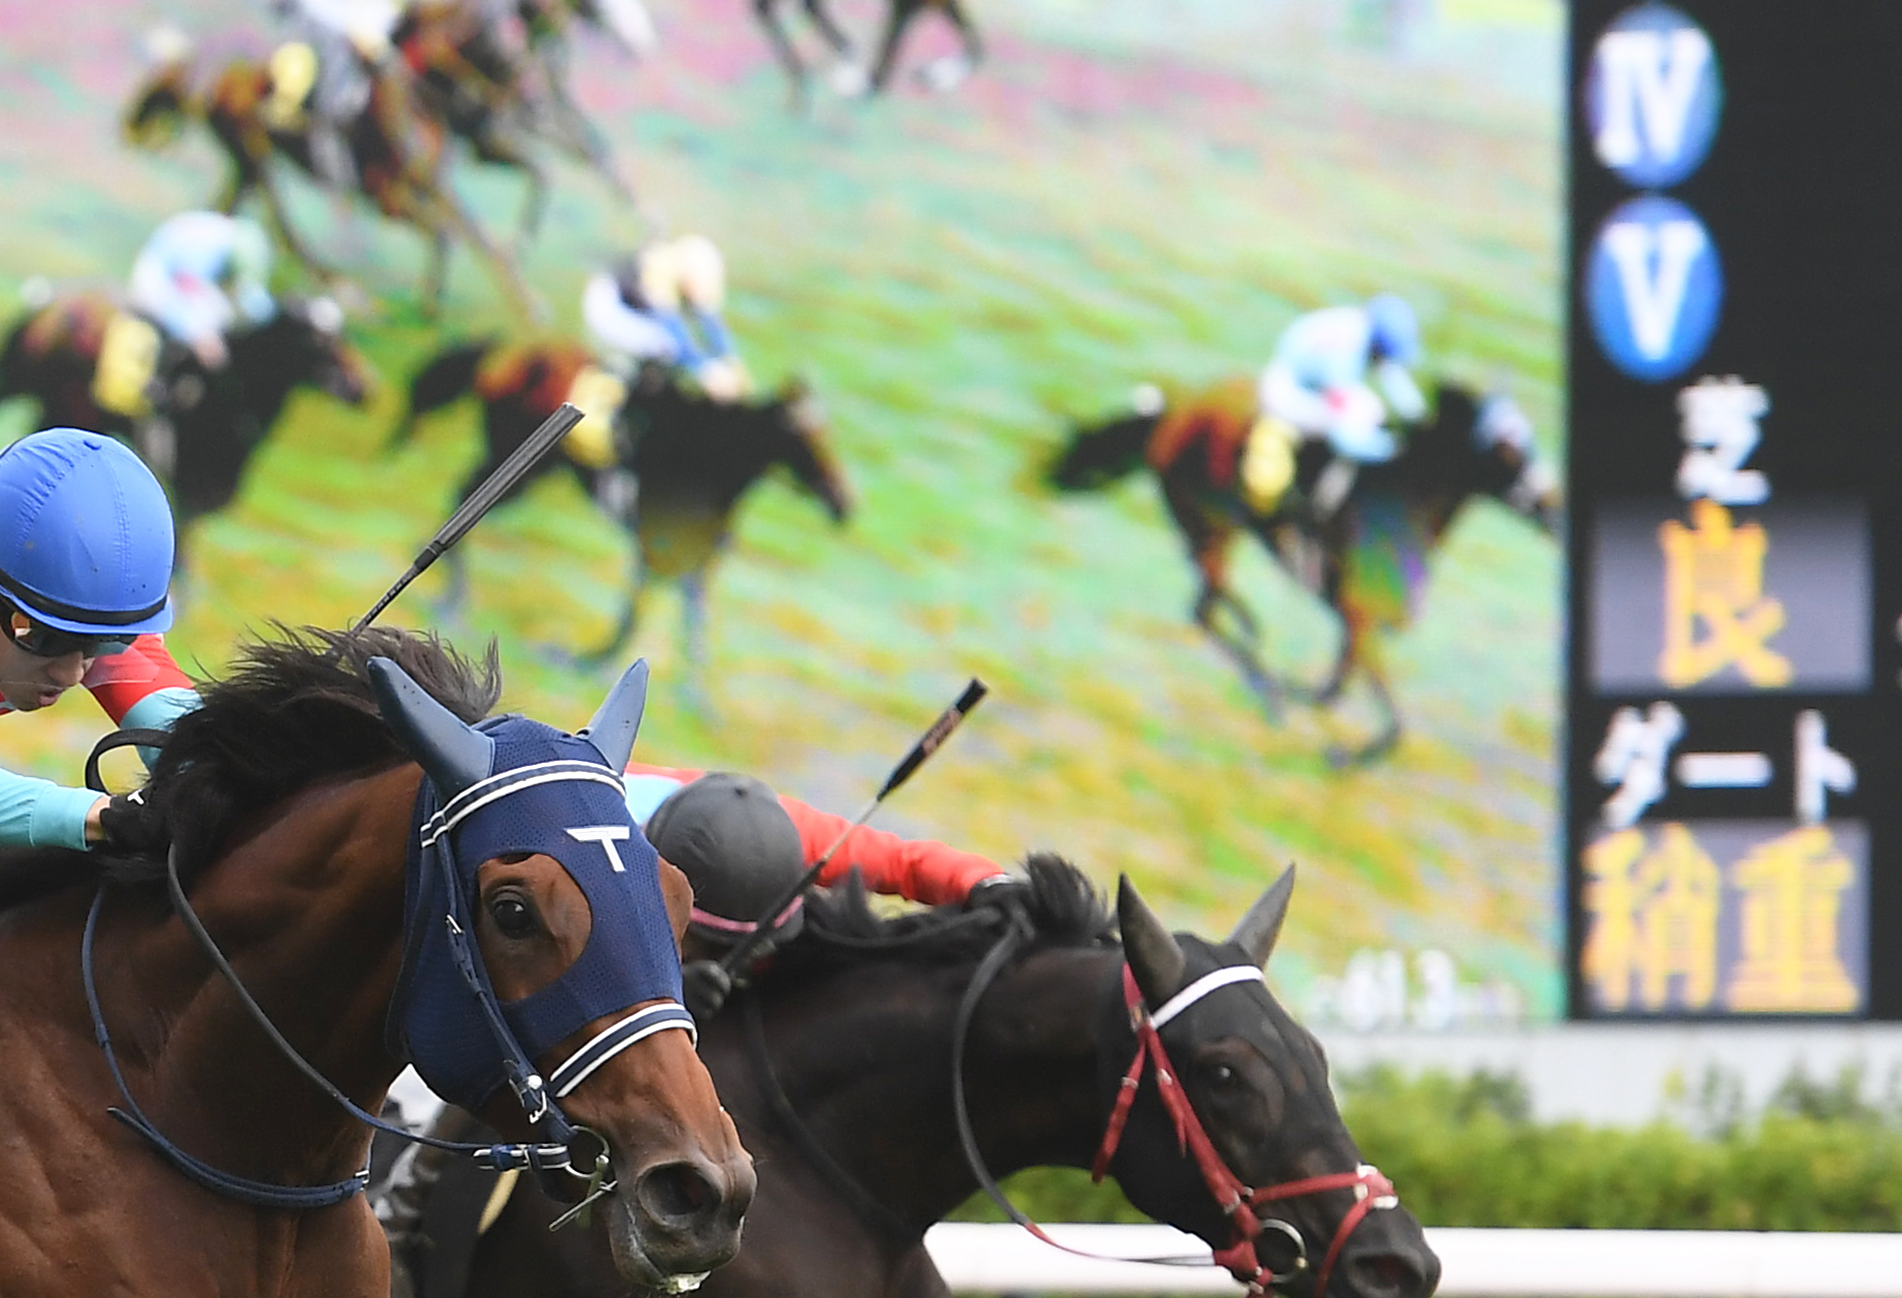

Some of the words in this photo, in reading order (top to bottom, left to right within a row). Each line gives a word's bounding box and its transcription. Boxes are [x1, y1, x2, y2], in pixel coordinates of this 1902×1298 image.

[1675, 374, 1772, 504] 芝
[1656, 499, 1793, 689] 良
[1593, 701, 1857, 828] ダート
[1580, 822, 1860, 1014] 稍重
